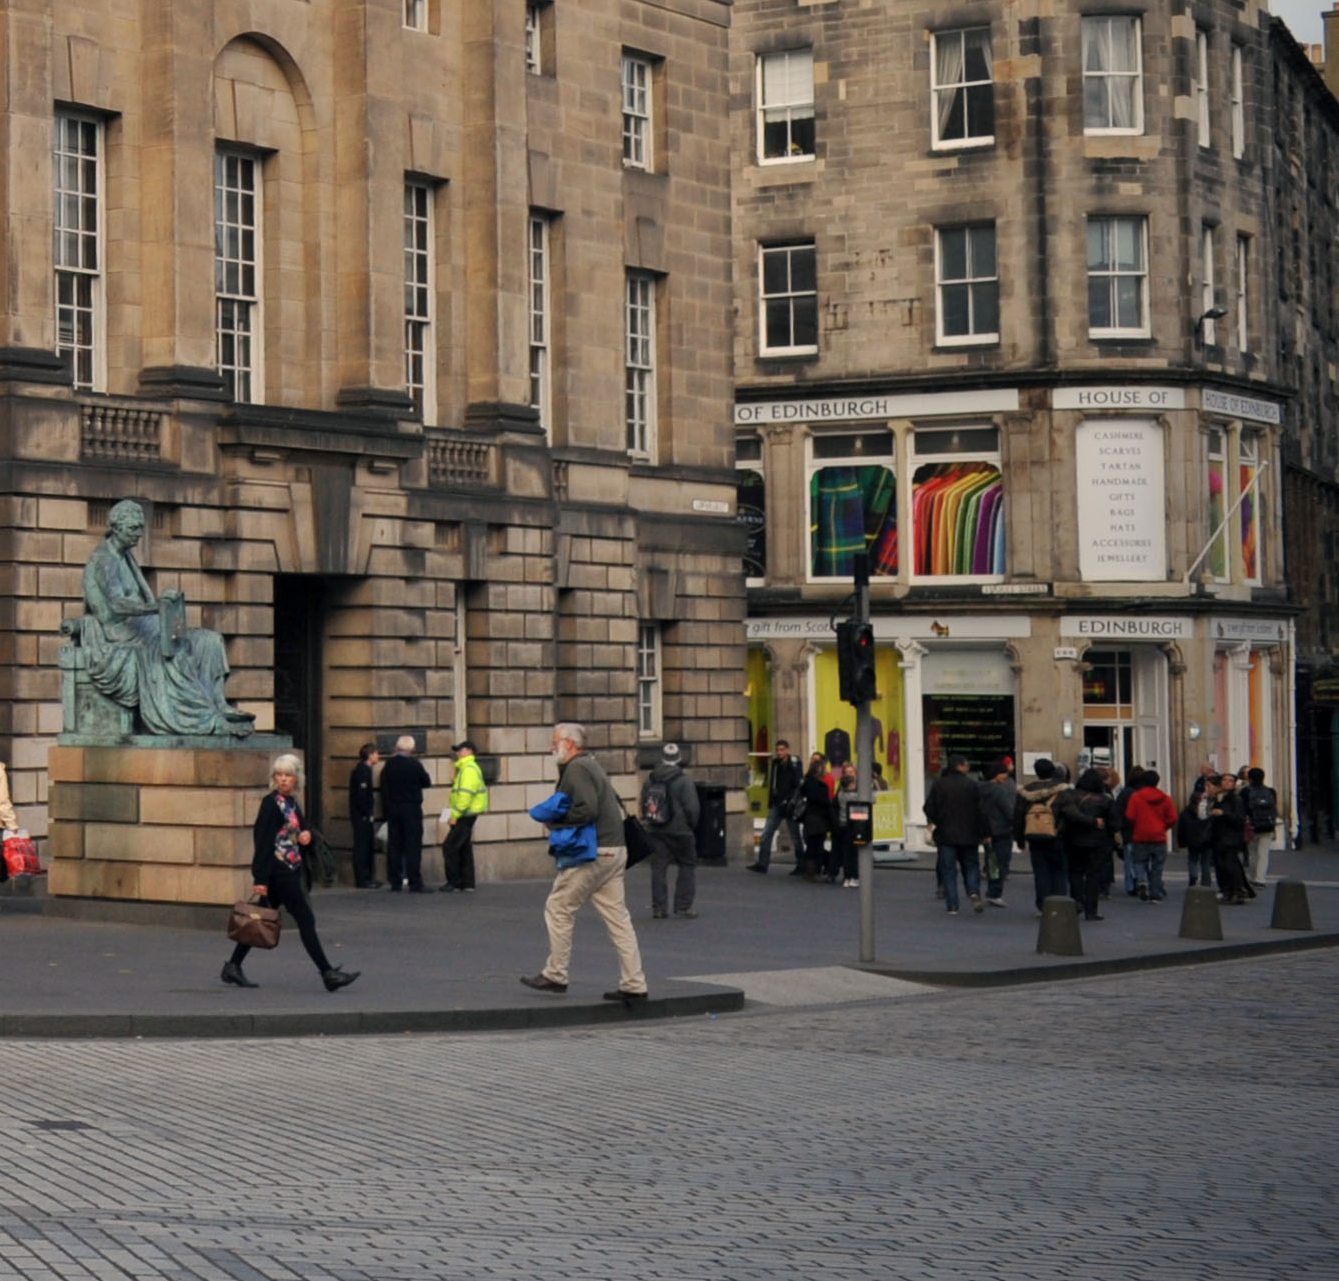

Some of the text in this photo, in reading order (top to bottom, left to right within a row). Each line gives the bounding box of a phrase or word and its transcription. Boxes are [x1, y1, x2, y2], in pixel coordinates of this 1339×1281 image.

[1079, 391, 1169, 404] HOUSE OF
[737, 400, 888, 421] OF EDINBURGH
[1093, 432, 1144, 440] CASHMERE
[1098, 447, 1142, 456] SCARVES
[1101, 462, 1142, 471] TARTAN
[1092, 478, 1148, 486] HANDMADE
[1109, 493, 1135, 501] GIFTS
[1110, 508, 1135, 516] BAGS
[1110, 524, 1135, 532] HATS
[1092, 539, 1152, 547] ACCESSORIES
[1097, 554, 1146, 563] JEWELLERY
[753, 622, 770, 636] gift
[774, 621, 801, 632] from
[1079, 620, 1182, 635] EDINBURGH
